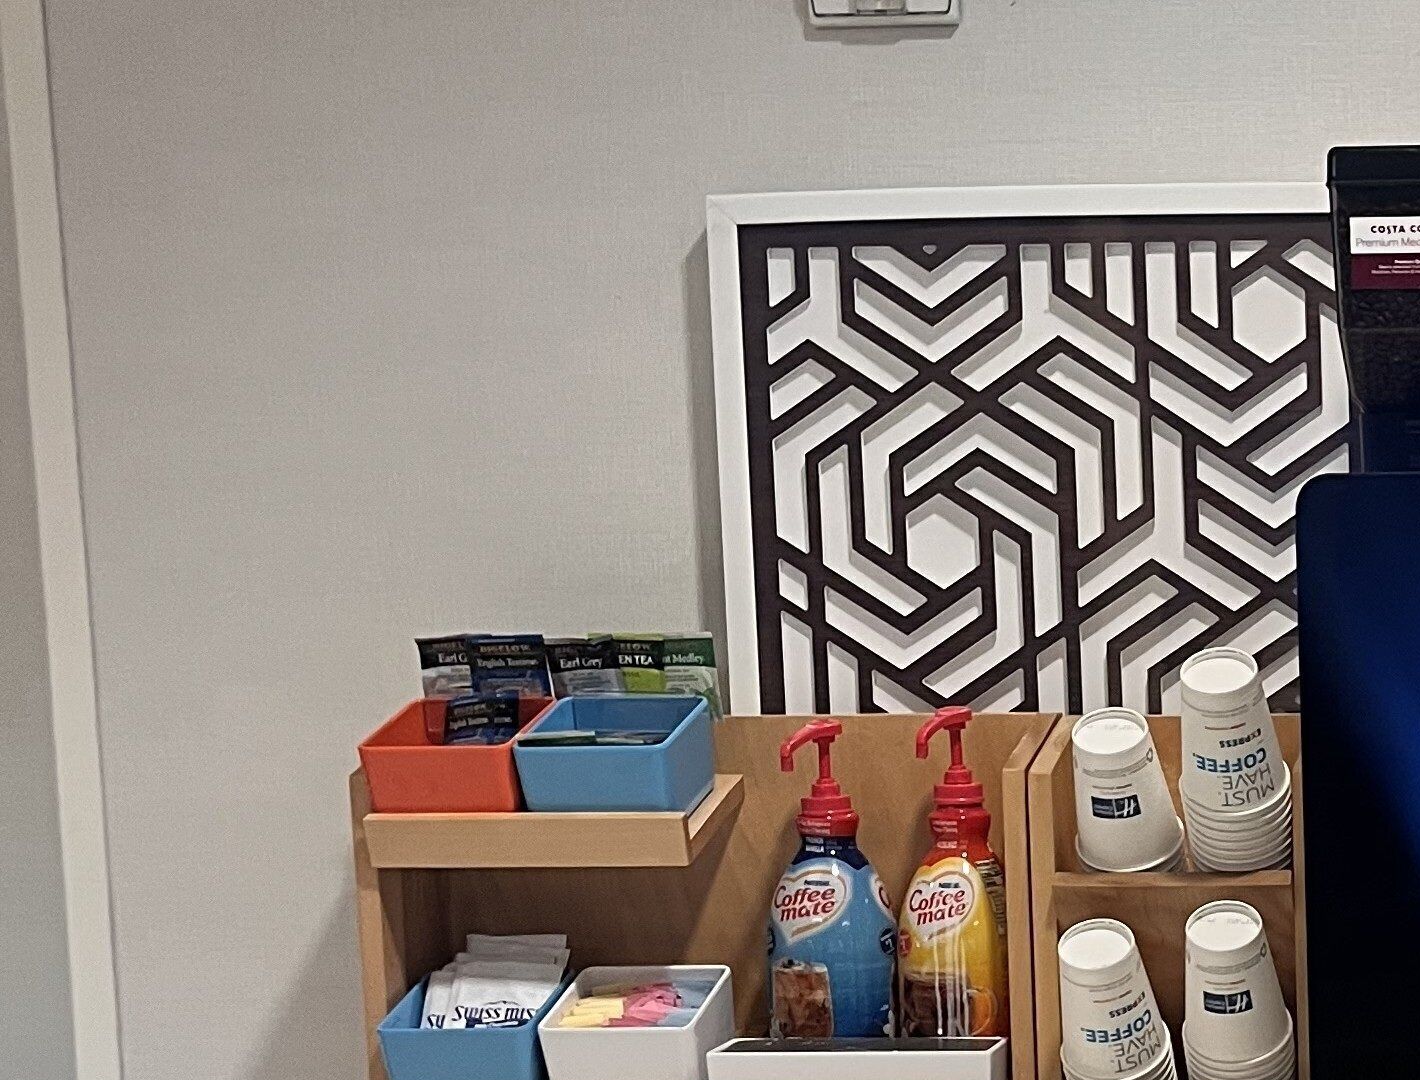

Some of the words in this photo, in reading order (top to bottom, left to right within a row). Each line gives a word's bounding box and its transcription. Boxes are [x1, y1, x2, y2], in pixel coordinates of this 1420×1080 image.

[1370, 225, 1406, 235] COSTA
[1356, 237, 1399, 248] Premium
[559, 659, 580, 669] Earl
[634, 654, 654, 665] TEA
[774, 885, 836, 909] Coffee
[780, 900, 836, 922] mate
[916, 902, 967, 926] mate
